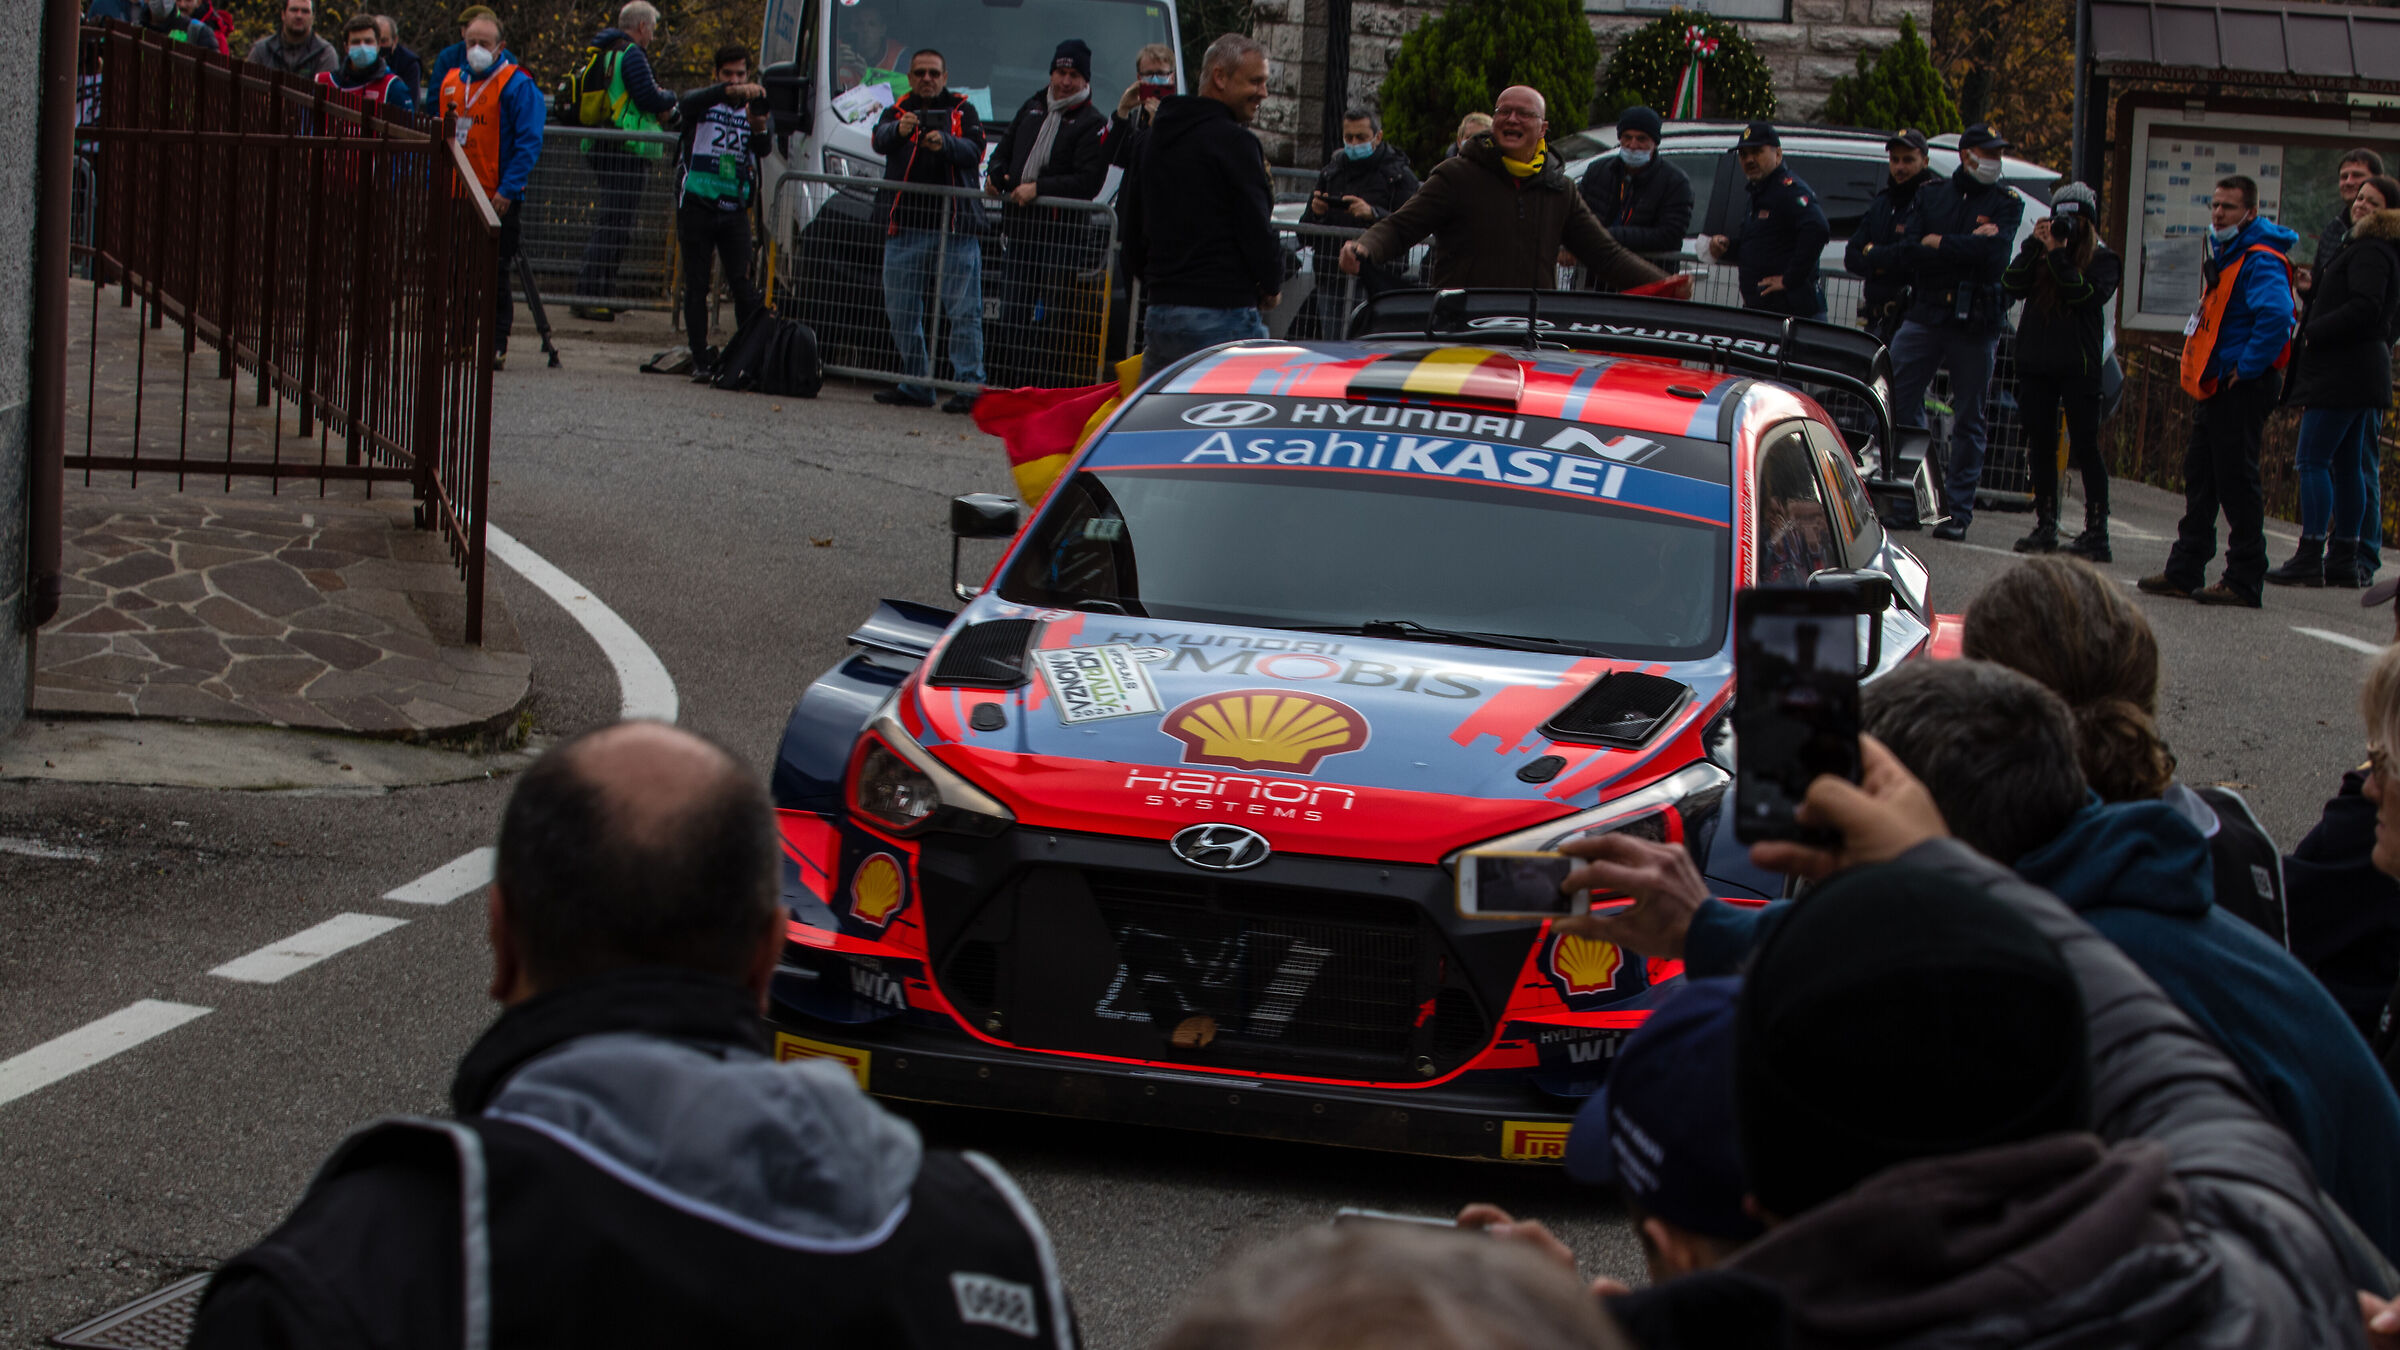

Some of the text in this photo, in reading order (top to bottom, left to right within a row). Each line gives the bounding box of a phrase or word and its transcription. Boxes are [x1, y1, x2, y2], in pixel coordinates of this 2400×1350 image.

[2207, 69, 2286, 85] MONTANA
[1568, 322, 1781, 355] HYUNDAI
[1290, 403, 1526, 441] HYUNDAI
[1104, 631, 1347, 657] HYUNDAI
[1048, 660, 1093, 712] MONZA
[1160, 645, 1485, 700] MOBIS
[1144, 795, 1323, 823] SYSTEMS
[1567, 1037, 1616, 1064] WI
[1513, 1130, 1569, 1157] PIR
